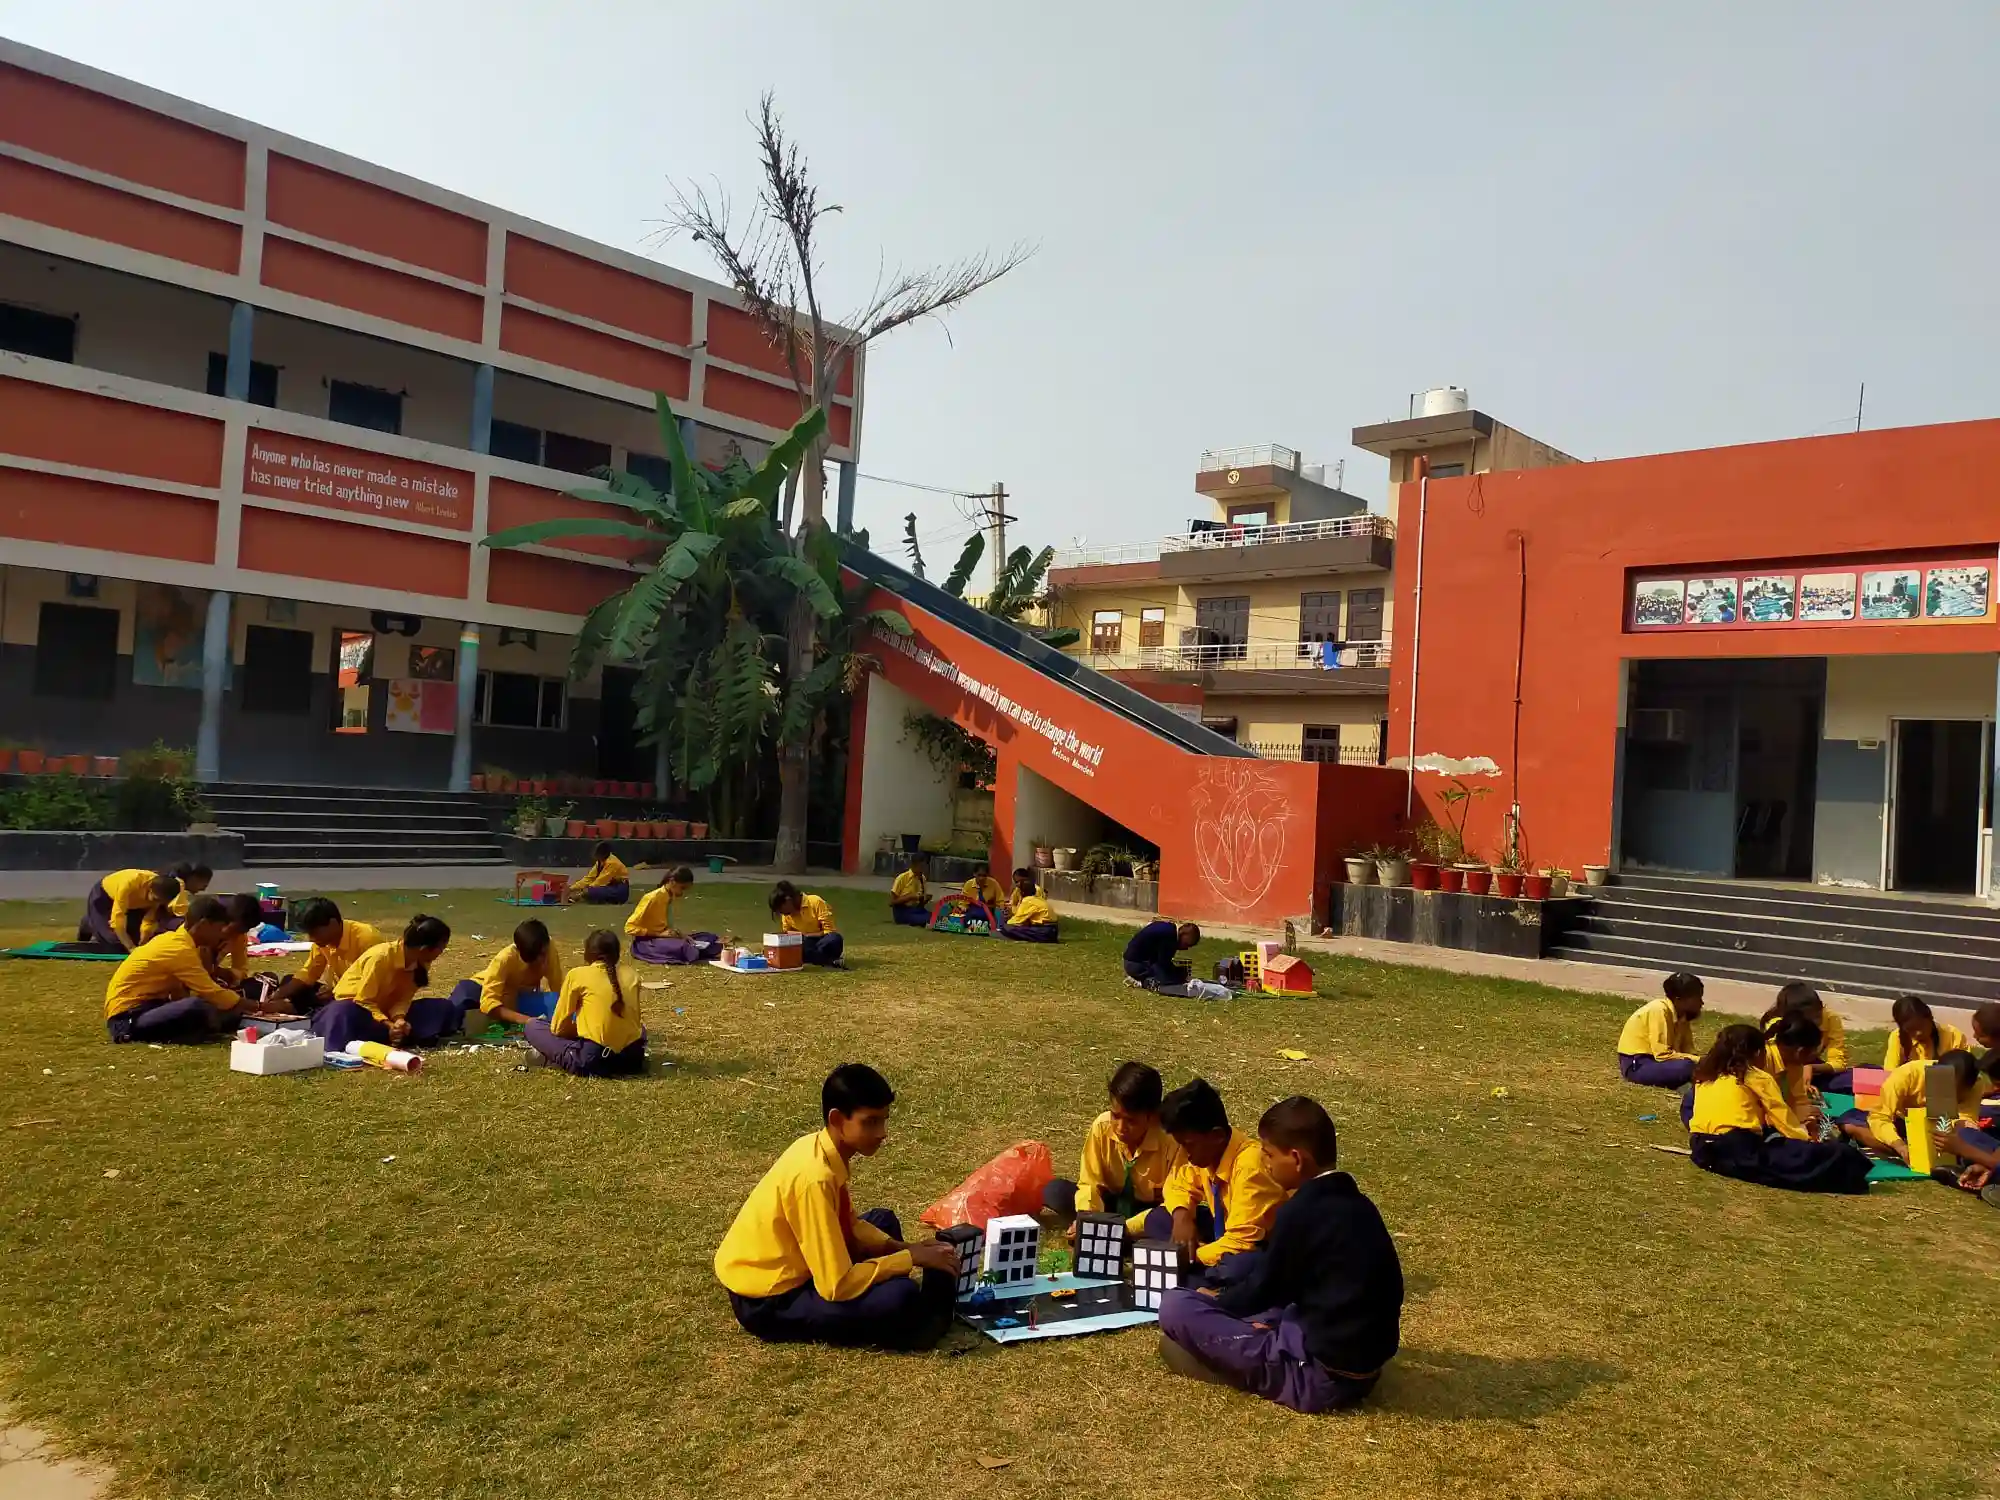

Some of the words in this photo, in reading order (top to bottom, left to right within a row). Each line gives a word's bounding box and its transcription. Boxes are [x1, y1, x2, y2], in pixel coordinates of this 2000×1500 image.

[251, 467, 271, 485] has
[274, 475, 301, 490] never
[304, 476, 333, 496] tried
[336, 485, 383, 509] anything
[386, 494, 410, 509] new
[252, 443, 287, 466] Anyone
[291, 453, 311, 469] who
[312, 455, 330, 473] has
[333, 464, 364, 479] never
[367, 469, 397, 487] made
[401, 477, 409, 489] a
[412, 478, 458, 498] mistake
[916, 648, 934, 669] most
[930, 656, 960, 684] powerful
[956, 671, 981, 697] weapon
[979, 683, 999, 706] which
[996, 694, 1011, 712] you
[1008, 701, 1022, 720] can
[1020, 708, 1035, 726] use
[1032, 710, 1042, 731] to
[1040, 717, 1066, 746] change
[1065, 728, 1080, 754] the
[1078, 741, 1104, 766] world
[1052, 746, 1070, 763] Nelson
